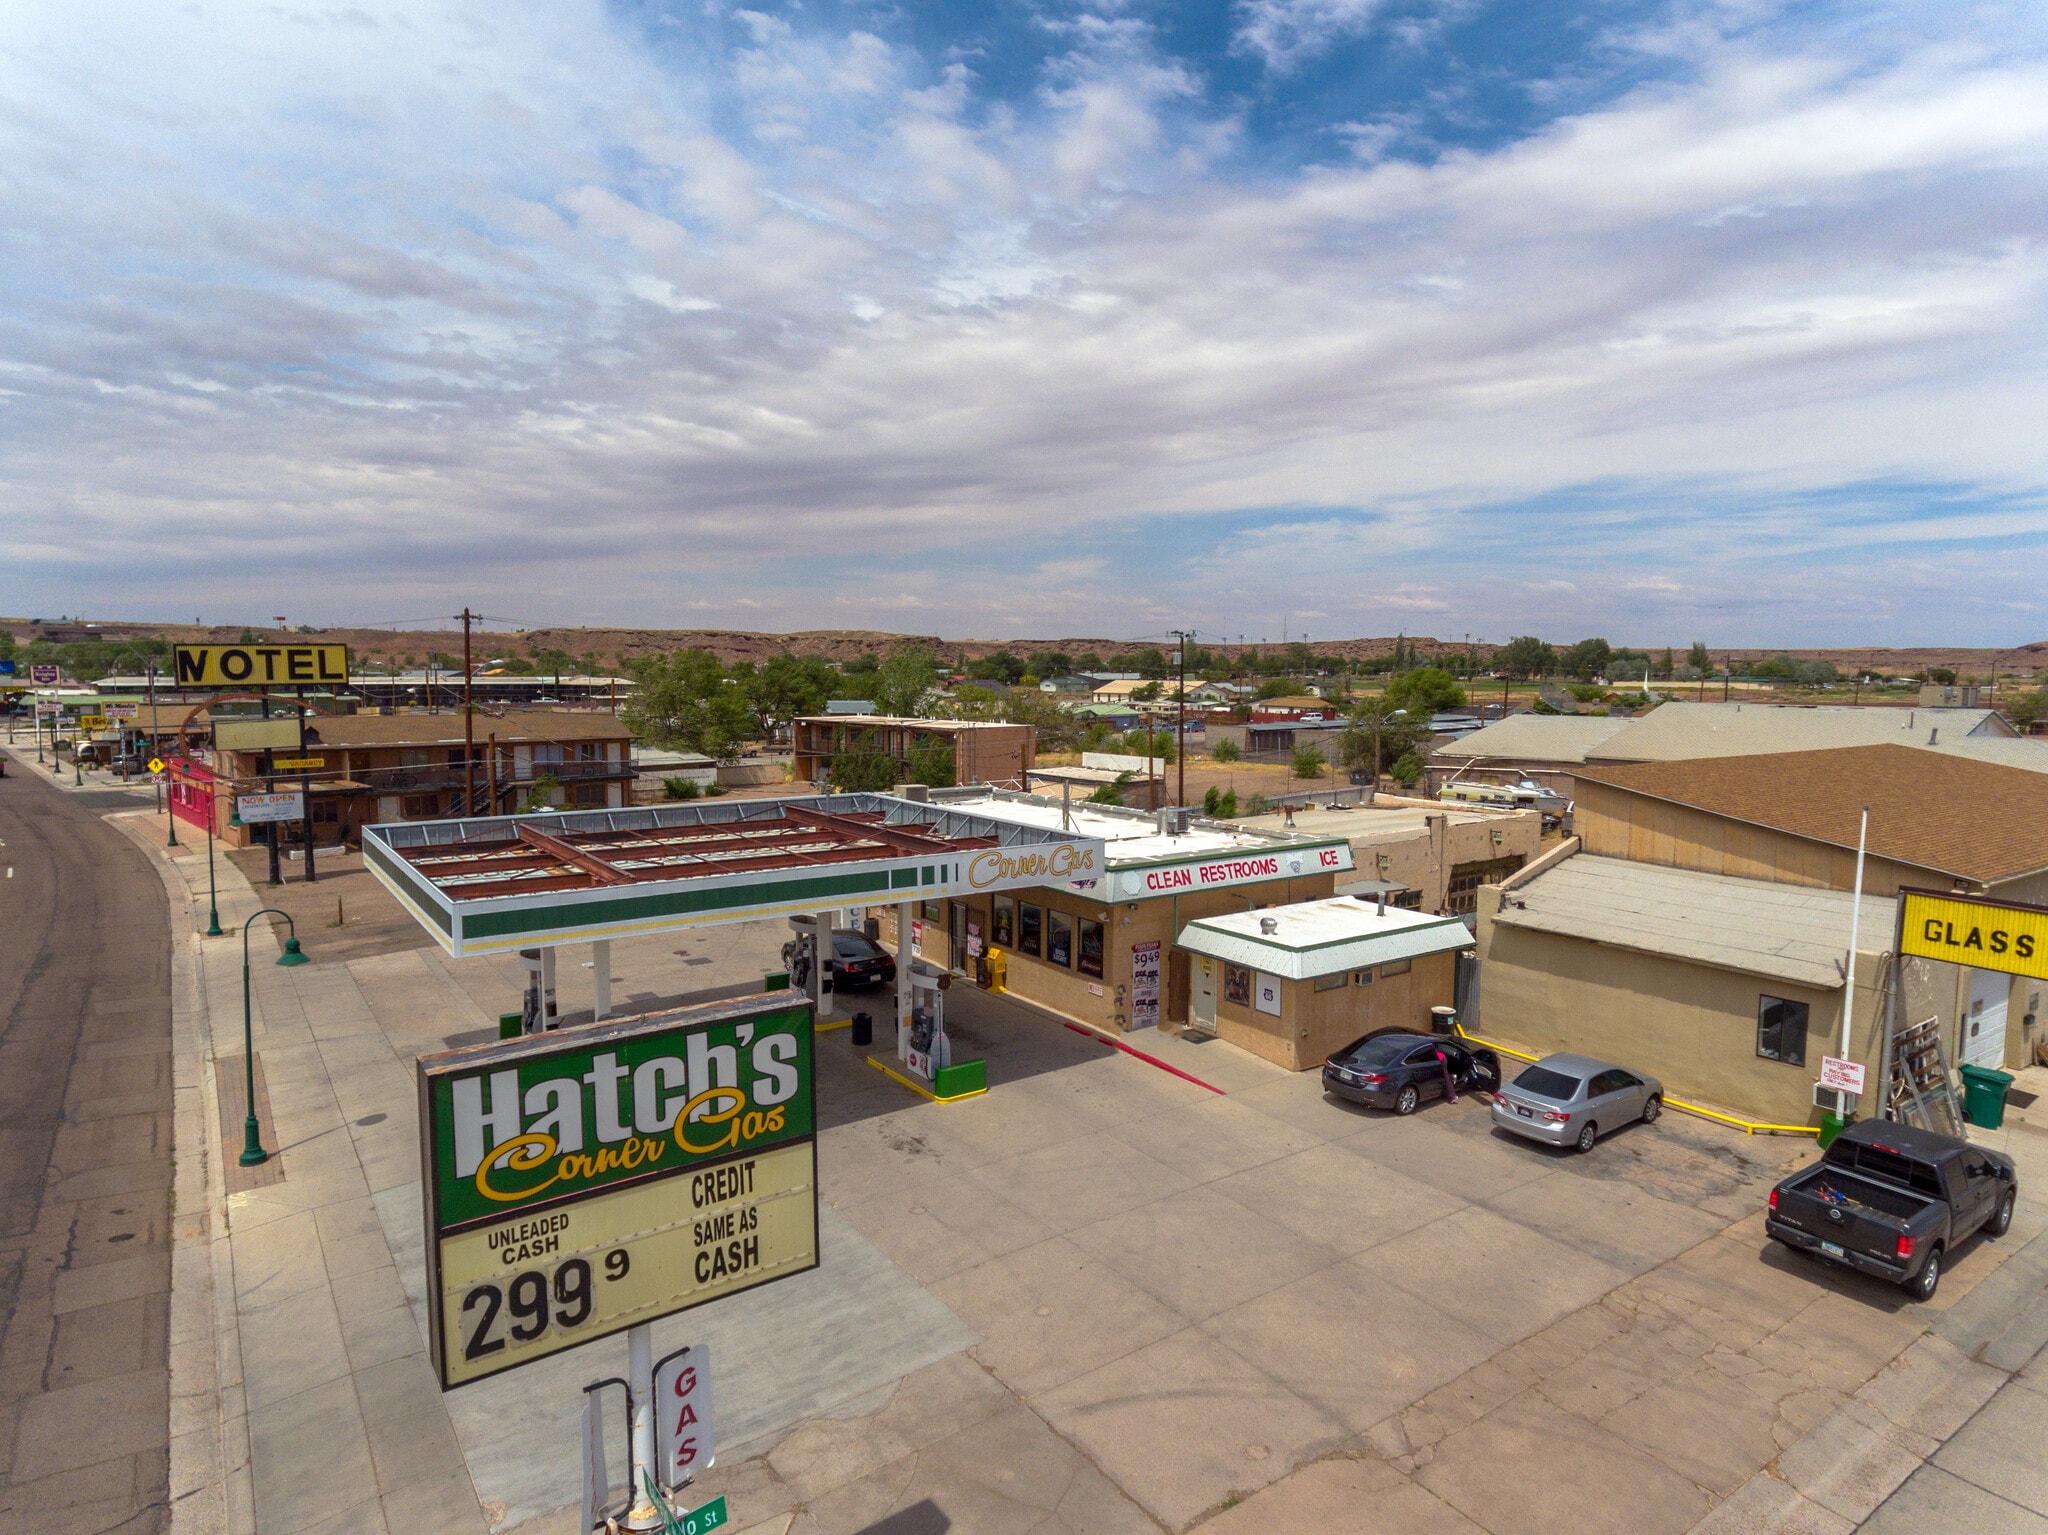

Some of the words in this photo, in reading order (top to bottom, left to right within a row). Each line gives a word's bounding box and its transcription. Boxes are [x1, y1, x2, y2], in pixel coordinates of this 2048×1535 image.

[289, 759, 323, 767] VACANCY
[241, 796, 265, 805] NOW
[269, 794, 296, 803] OPEN
[968, 851, 1048, 888] Corner
[1049, 845, 1094, 876] Gas
[1146, 869, 1193, 891] CLEAN
[1200, 858, 1278, 884] RESTROOMS
[1319, 850, 1339, 867] ICE
[1924, 918, 2036, 958] GLASS
[1823, 1072, 1860, 1085] CUSTOMERS
[1825, 1058, 1859, 1072] RESTROOMS
[450, 1023, 799, 1180] Hatch's
[475, 1133, 666, 1201] Corner
[673, 1086, 785, 1154] Gas
[691, 1162, 756, 1209] CREDIT
[488, 1213, 570, 1251] UNLEADED
[693, 1213, 736, 1248] SAME
[739, 1206, 758, 1231] AS
[1779, 1214, 1802, 1226] TITAN
[502, 1235, 560, 1265] CASH
[694, 1235, 760, 1284] CASH
[674, 1366, 698, 1467] GAS
[704, 1510, 718, 1527] St
